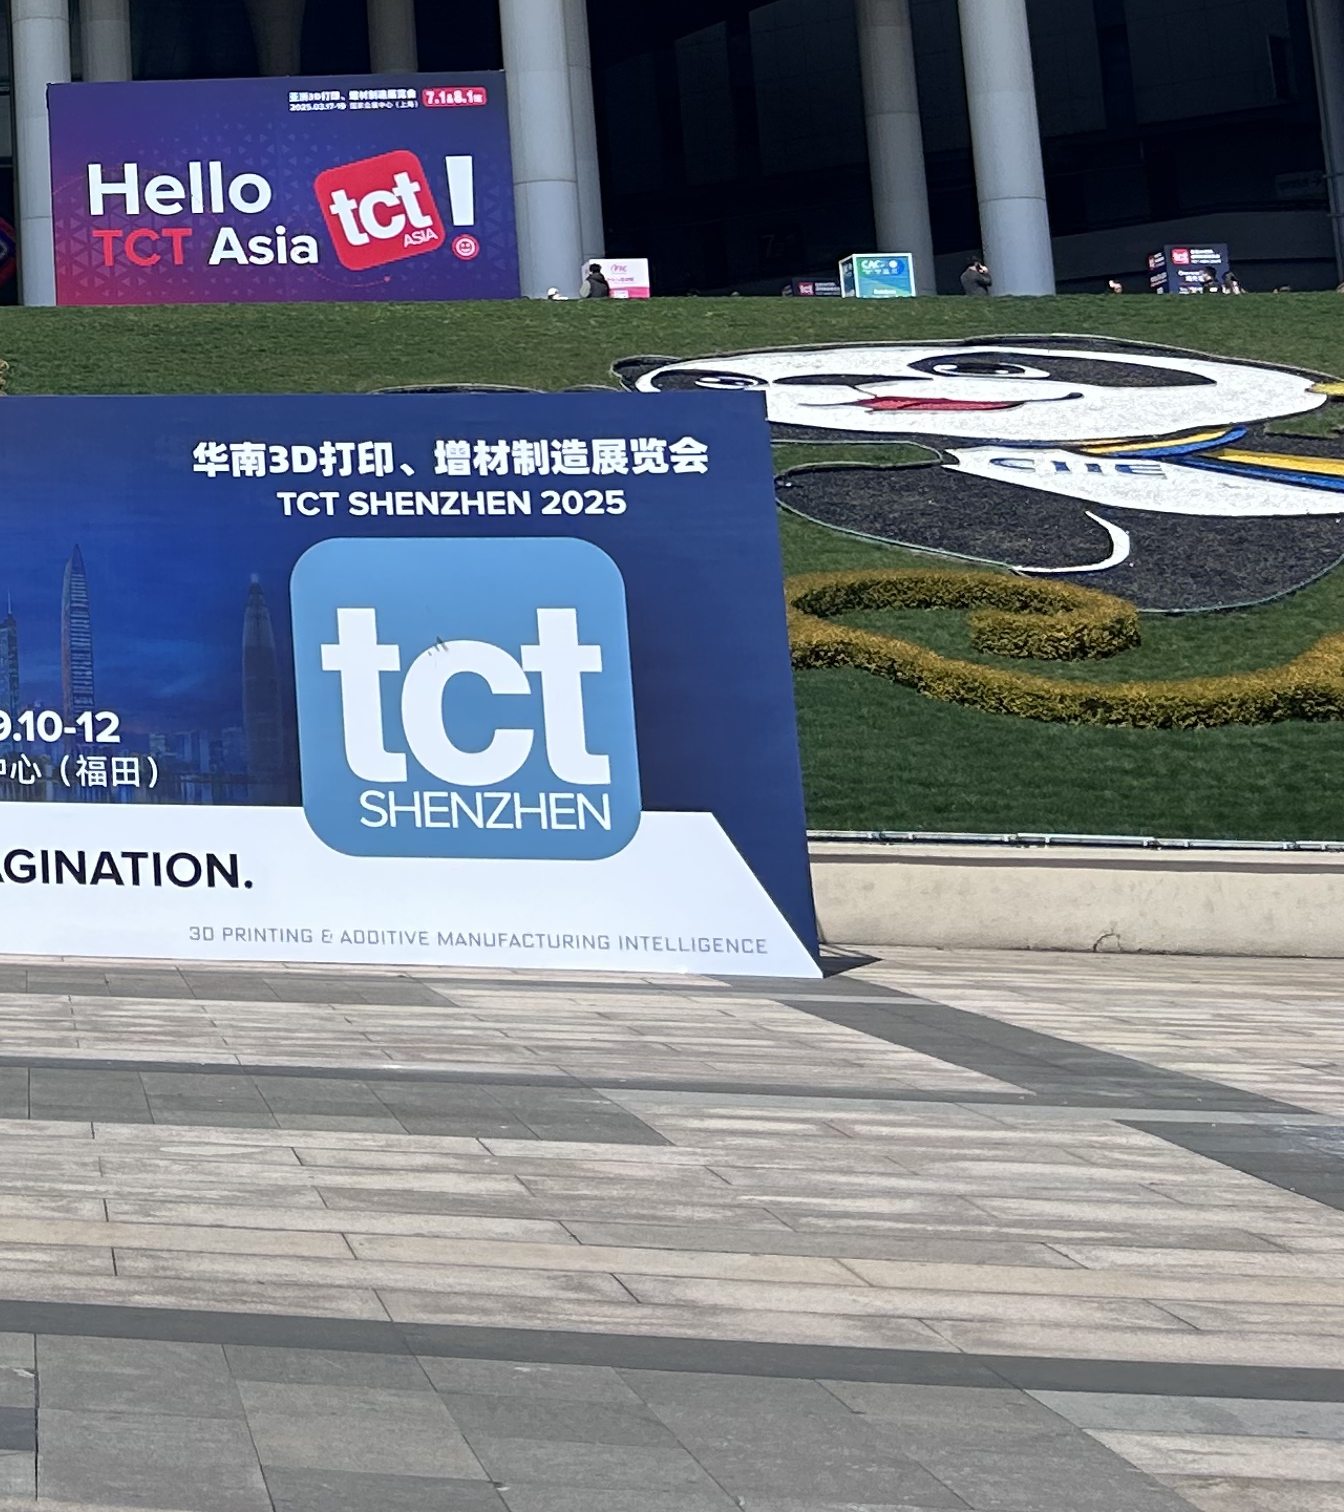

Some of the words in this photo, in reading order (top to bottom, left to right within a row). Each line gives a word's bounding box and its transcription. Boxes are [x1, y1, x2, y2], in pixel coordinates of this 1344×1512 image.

[88, 160, 272, 216] Hello
[329, 172, 434, 247] tct
[92, 227, 192, 267] TCT
[208, 225, 319, 266] Asia
[403, 228, 439, 249] ASIA
[192, 438, 709, 478] 华南3D打印、增材制造展览会
[988, 457, 1166, 480] CIIE
[276, 491, 341, 516] TCT
[347, 491, 532, 517] SHENZHEN
[540, 490, 627, 517] 2025
[320, 607, 611, 786] tct
[359, 790, 611, 831] SHENZHEN
[189, 926, 215, 941] 3D
[222, 927, 313, 943] PRINTING
[340, 929, 430, 946] ADDITIVE
[437, 931, 610, 950] MANUFACTURING
[618, 935, 768, 954] INTELLIGENCE
